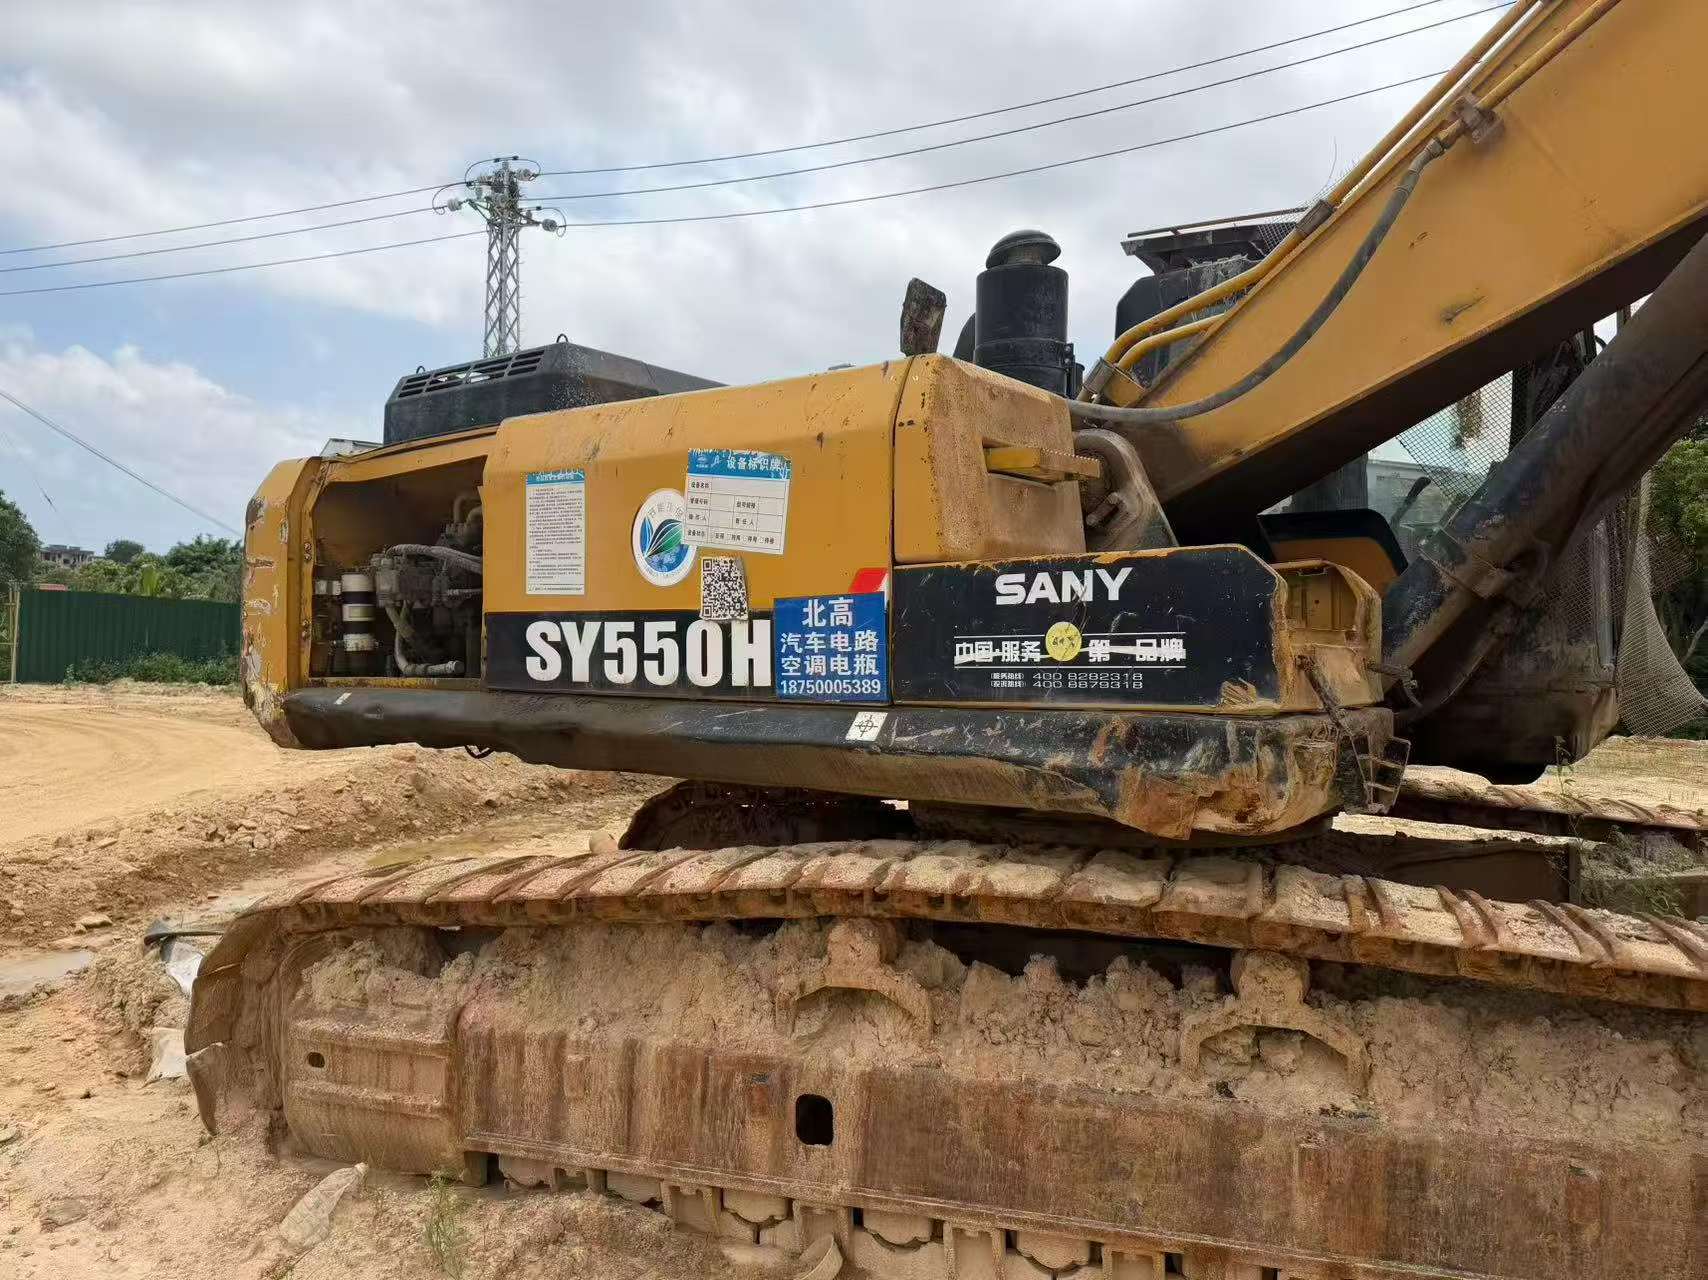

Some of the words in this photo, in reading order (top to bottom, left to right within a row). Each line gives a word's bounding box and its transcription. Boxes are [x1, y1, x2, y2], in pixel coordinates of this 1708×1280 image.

[995, 567, 1133, 605] SANY
[802, 597, 854, 628] 北高
[780, 629, 880, 653] 汽车电路
[525, 619, 772, 688] SY550H
[781, 653, 880, 676] 空调电瓶
[780, 679, 881, 694] 18750005389
[1032, 672, 1062, 681] 400
[1032, 680, 1062, 689] 400
